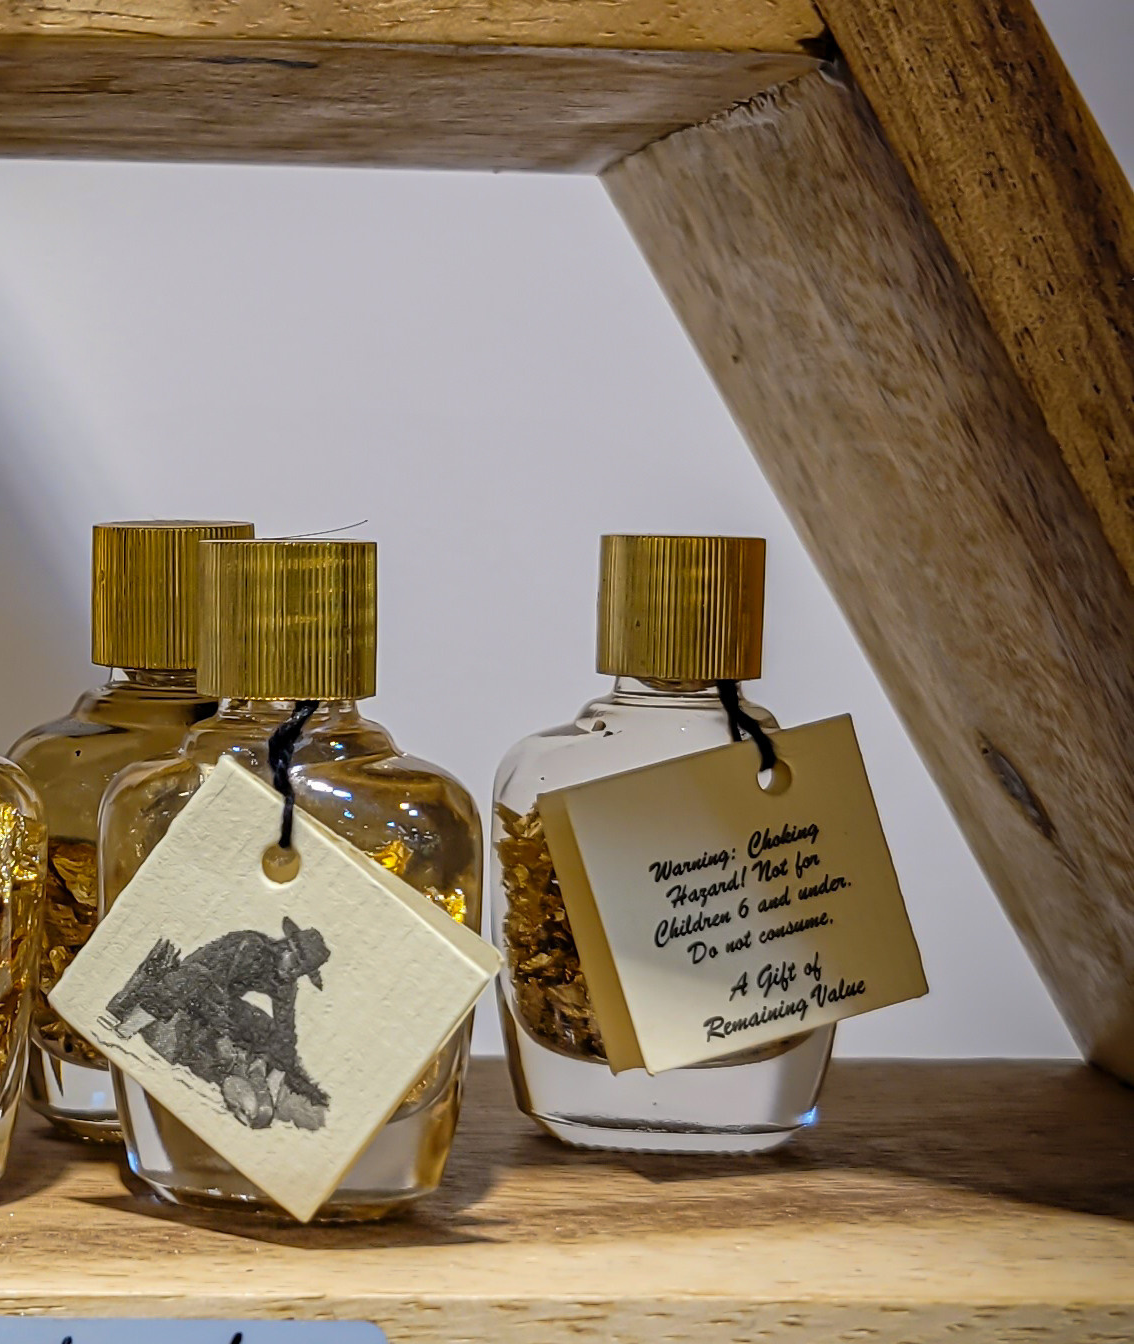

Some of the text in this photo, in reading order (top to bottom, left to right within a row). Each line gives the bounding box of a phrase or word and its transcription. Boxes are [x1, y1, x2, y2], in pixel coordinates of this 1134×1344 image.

[649, 822, 819, 883] Warning: Choking
[666, 853, 820, 909] Hazard! Not for
[654, 873, 852, 948] Children 6 and under.
[687, 909, 834, 965] Do not consume.
[729, 952, 821, 1001] A Gift of
[703, 979, 866, 1042] Remaining Value
